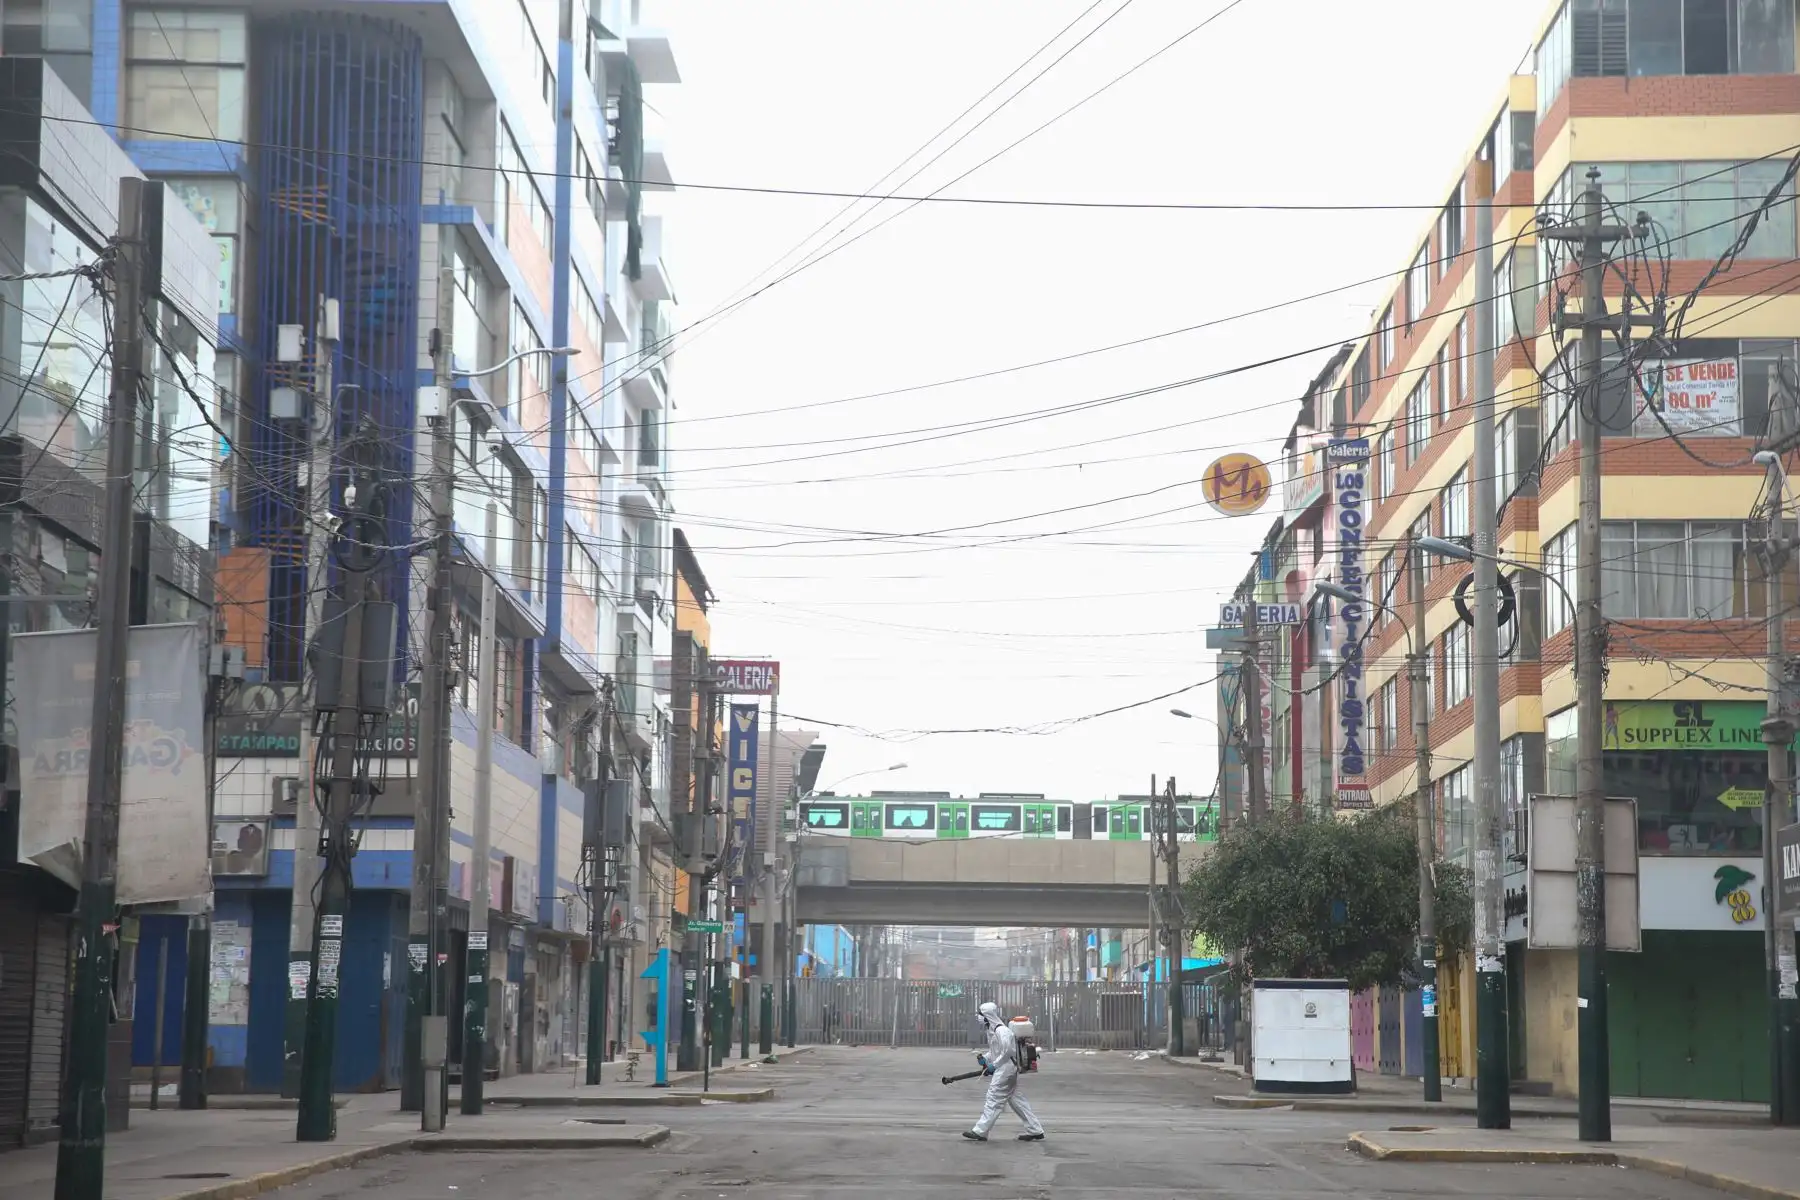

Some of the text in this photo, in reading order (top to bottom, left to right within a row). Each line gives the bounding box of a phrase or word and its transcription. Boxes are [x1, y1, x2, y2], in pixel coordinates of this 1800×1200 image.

[1666, 362, 1735, 382] SE VENDE
[1328, 444, 1369, 457] Galeria
[1336, 473, 1364, 489] LOS
[1222, 605, 1298, 623] GAERIA
[1624, 727, 1712, 743] SUPPLEX
[1339, 789, 1371, 801] ENTRADA
